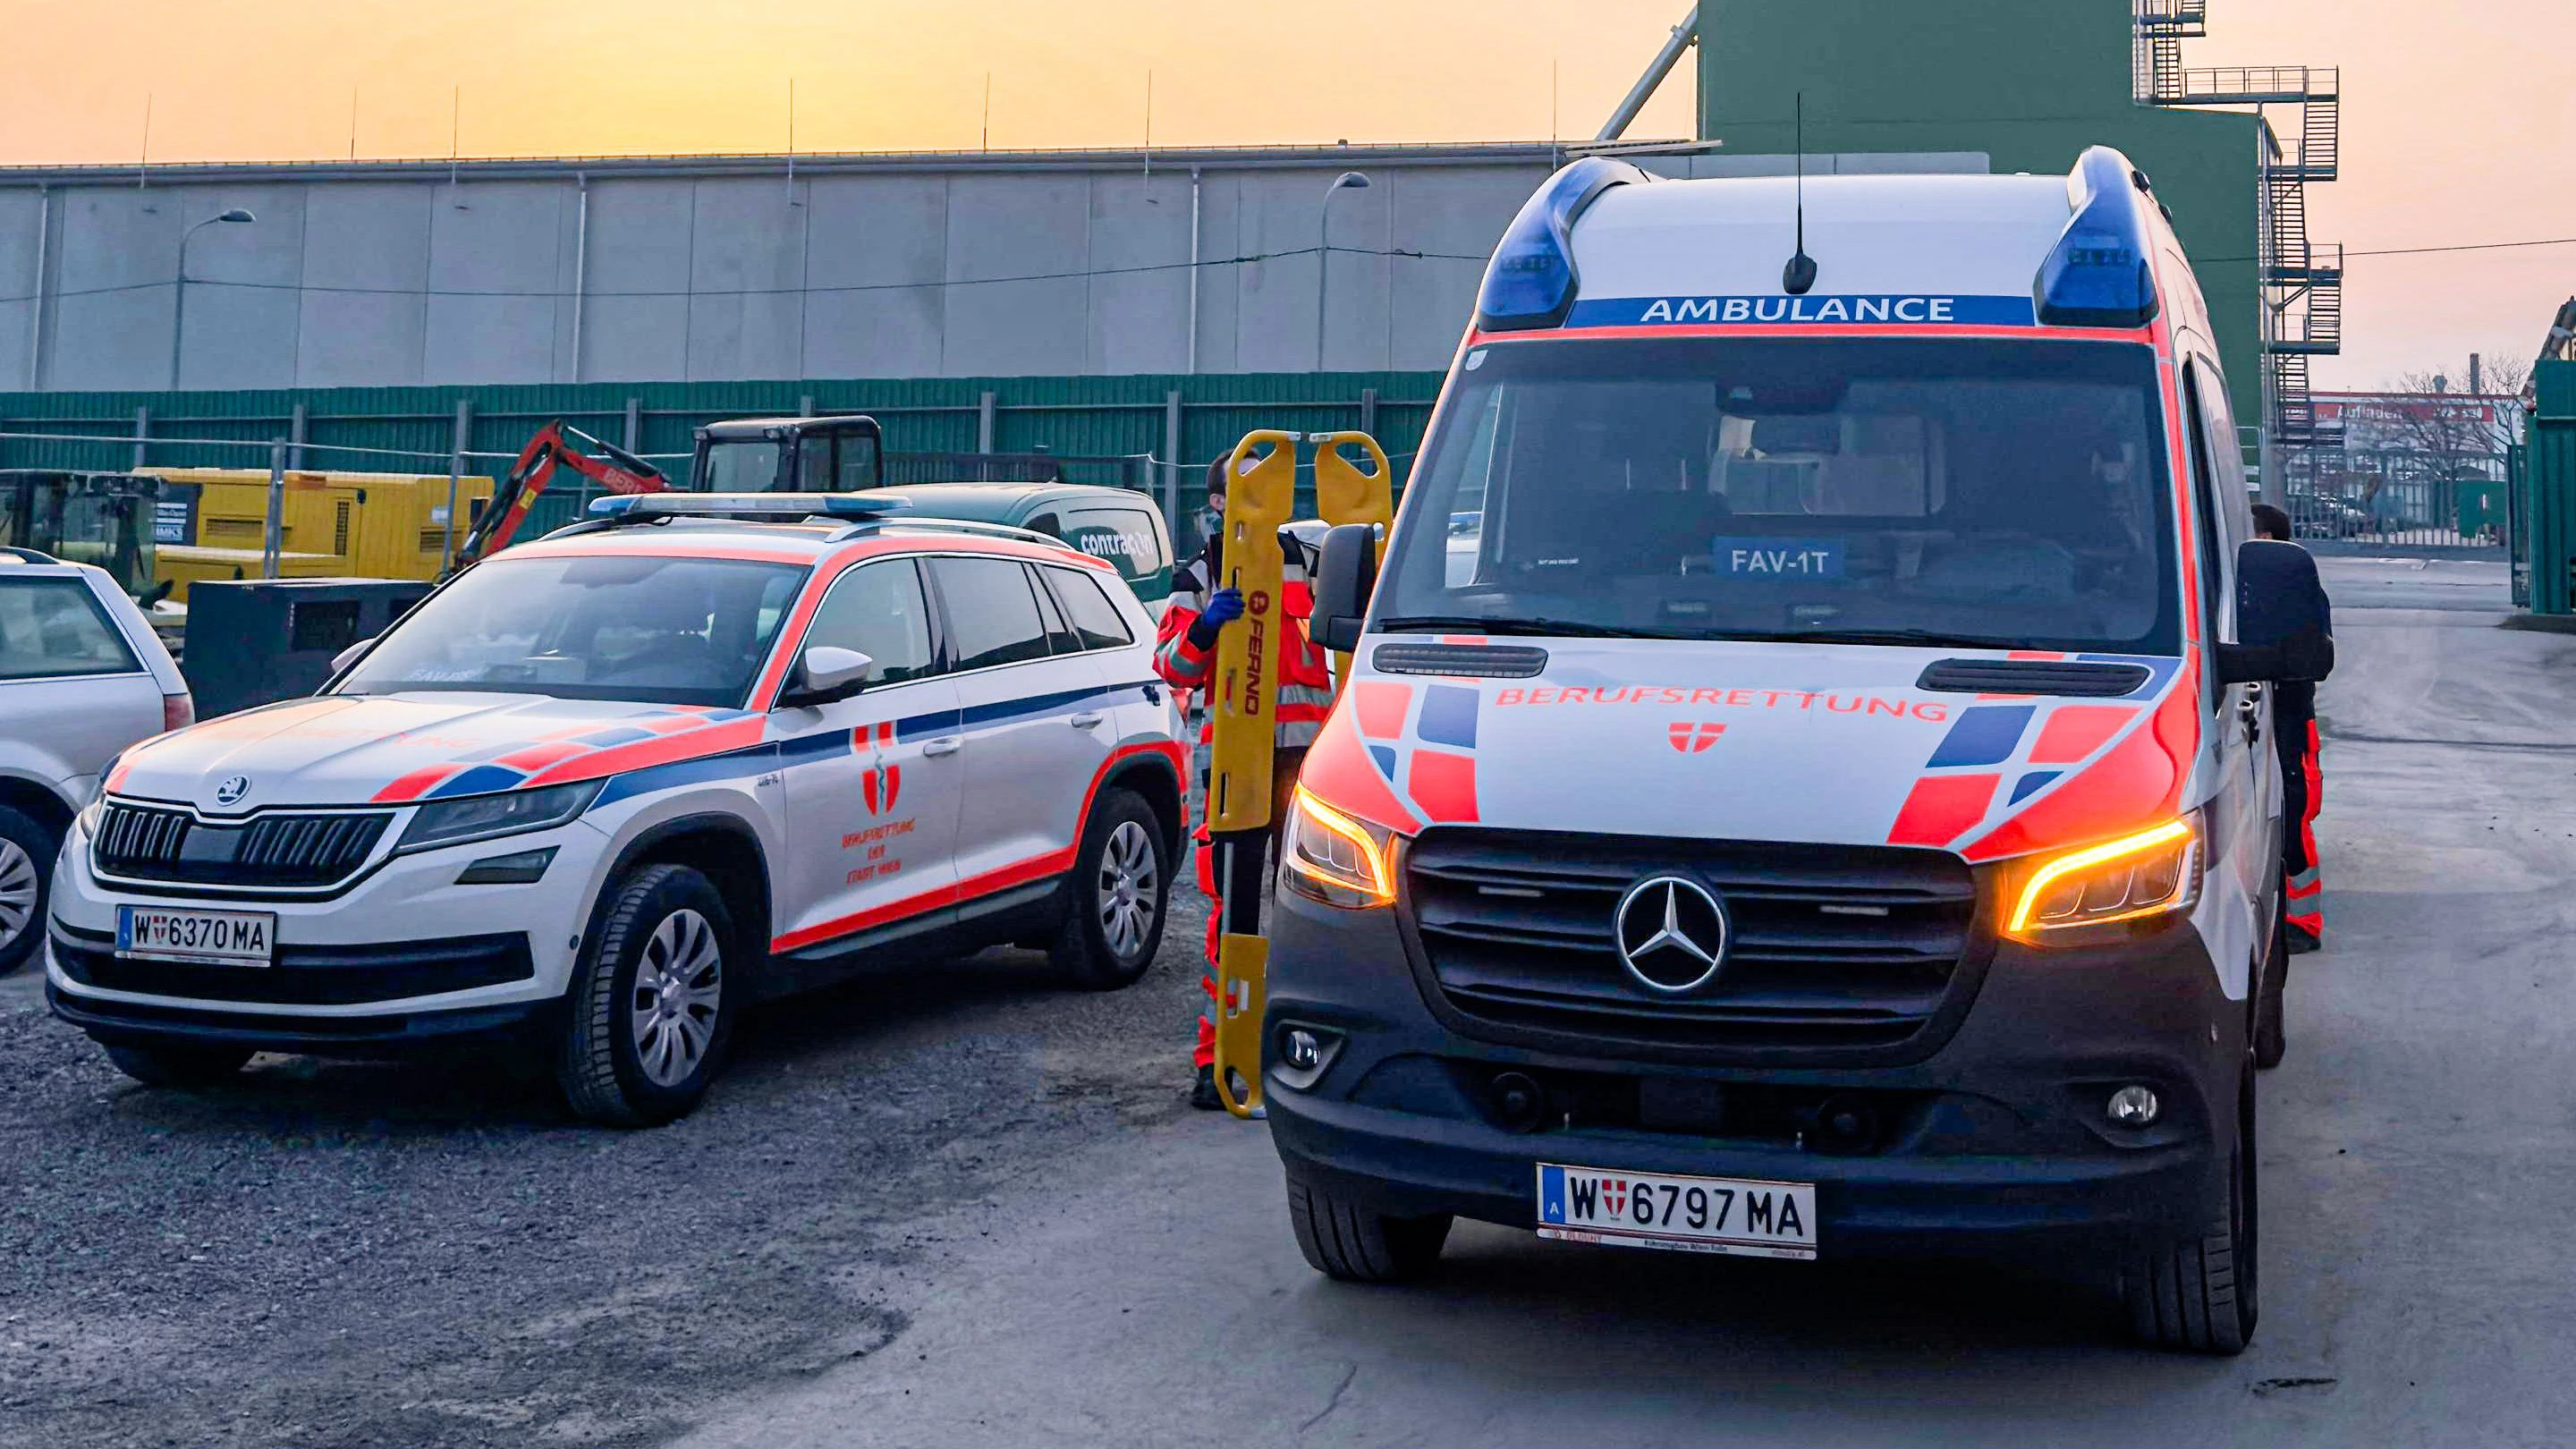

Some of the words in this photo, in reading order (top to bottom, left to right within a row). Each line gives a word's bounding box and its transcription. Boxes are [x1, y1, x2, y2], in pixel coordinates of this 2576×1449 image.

[1640, 298, 1954, 322] AMBULANCE
[1731, 549, 1829, 574] FAV-1T
[1244, 617, 1264, 716] FERNO
[1495, 686, 1948, 723] BERUFSRETTUNG
[135, 915, 151, 944] W
[1570, 1176, 1597, 1220] W
[1632, 1182, 1735, 1231] 6797
[1747, 1191, 1803, 1237] MA
